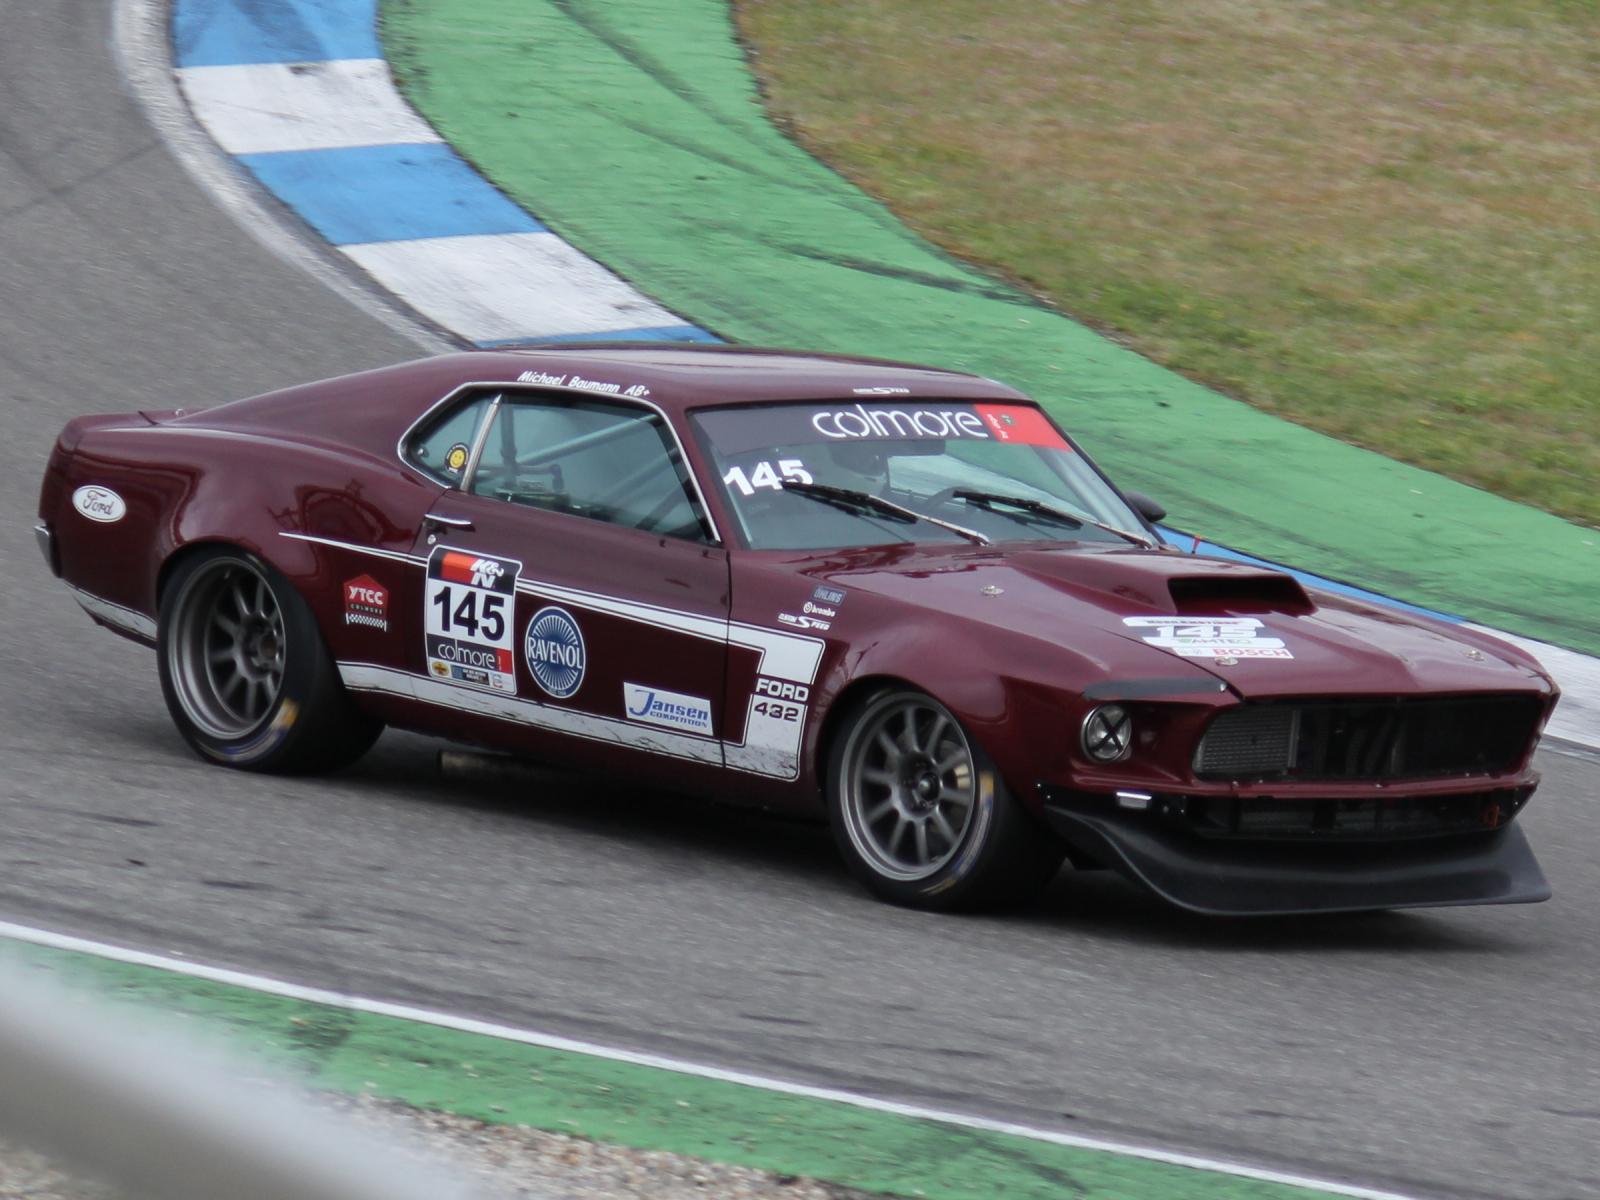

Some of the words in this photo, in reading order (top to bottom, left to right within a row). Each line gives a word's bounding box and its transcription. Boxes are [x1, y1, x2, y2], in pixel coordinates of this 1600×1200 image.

[517, 371, 566, 386] Michael
[568, 376, 620, 394] Baumann
[624, 385, 651, 397] AB+
[812, 403, 989, 438] colmore
[723, 459, 813, 496] 145
[83, 489, 115, 516] Ford
[349, 585, 384, 605] YTCC
[434, 585, 505, 641] 145
[811, 605, 837, 617] brembo
[1156, 625, 1257, 638] 145
[437, 639, 496, 669] colmore
[528, 636, 583, 669] RAVENOL
[1213, 648, 1292, 657] BOSCH
[756, 678, 809, 702] FORD
[629, 689, 709, 721] Jansen
[754, 702, 799, 722] 432
[650, 711, 708, 728] COMPETITION
